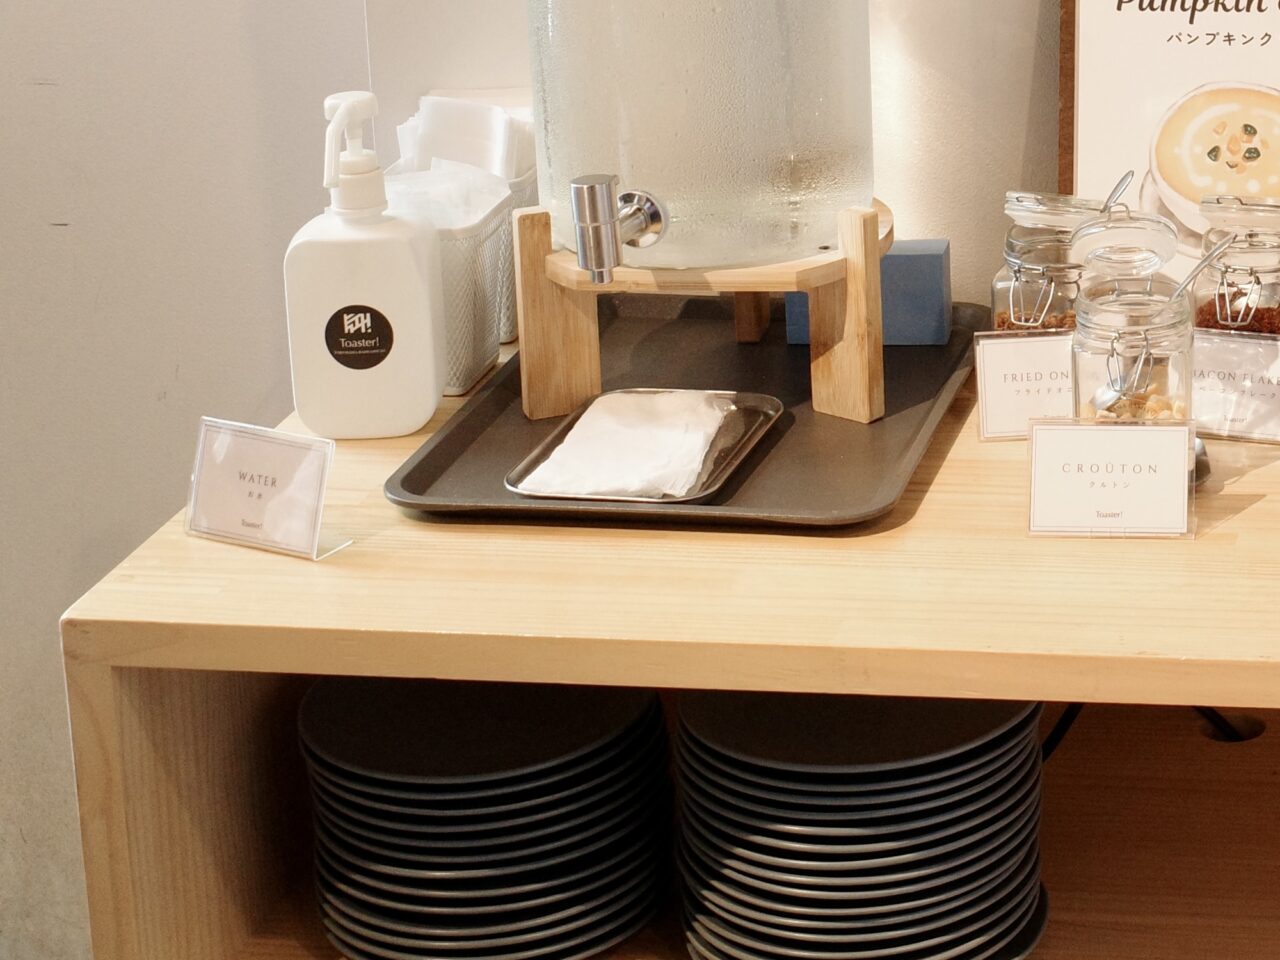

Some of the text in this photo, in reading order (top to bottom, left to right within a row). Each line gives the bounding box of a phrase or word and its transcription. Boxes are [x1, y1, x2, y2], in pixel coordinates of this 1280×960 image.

[339, 337, 380, 348] Toaster!
[1003, 371, 1043, 383] FRIED
[238, 470, 278, 488] WATER
